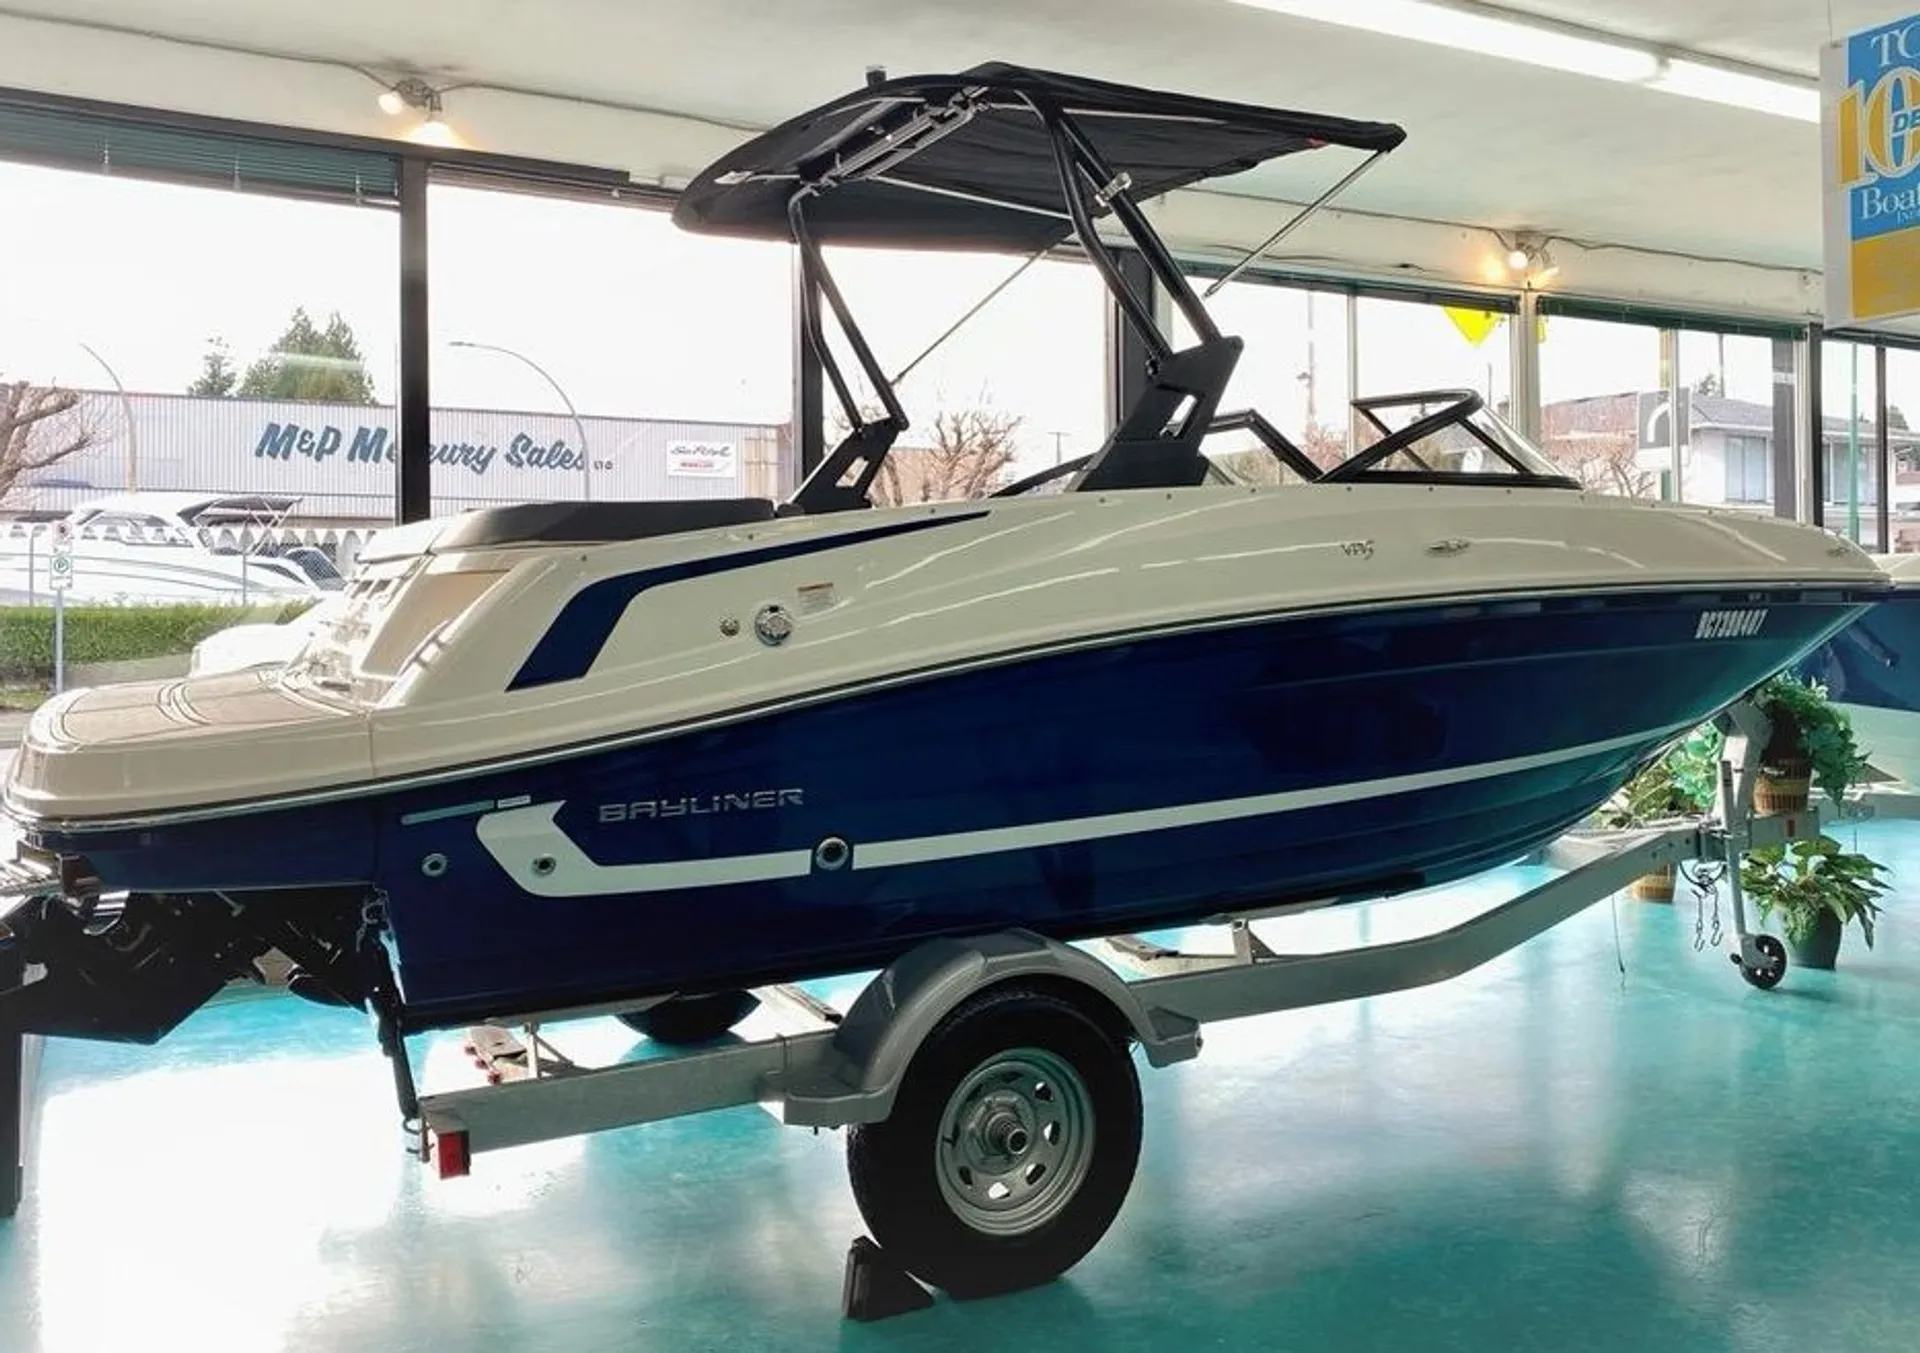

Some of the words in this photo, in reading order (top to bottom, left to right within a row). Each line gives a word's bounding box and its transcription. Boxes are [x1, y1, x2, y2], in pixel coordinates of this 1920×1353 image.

[255, 421, 342, 462] M&P
[347, 426, 497, 475] Meury
[504, 432, 584, 471] Sales
[598, 788, 804, 823] BAYLINER
